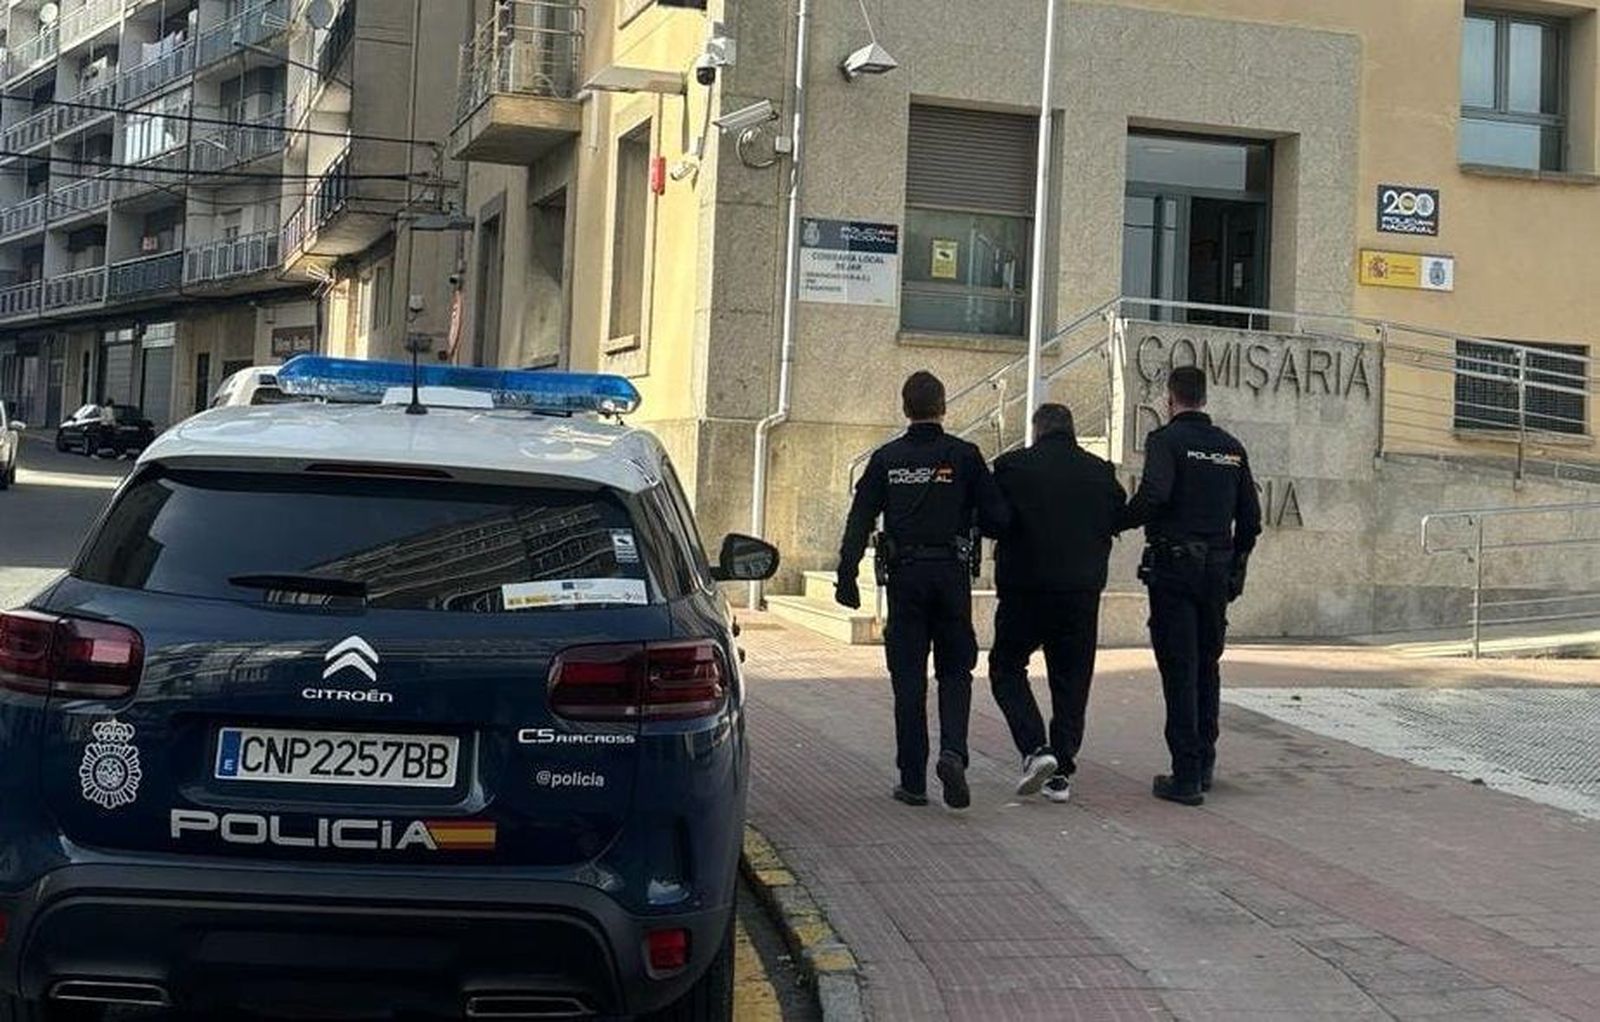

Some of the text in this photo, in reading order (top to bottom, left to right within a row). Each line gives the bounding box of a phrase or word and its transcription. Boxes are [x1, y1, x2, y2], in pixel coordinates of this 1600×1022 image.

[1383, 190, 1435, 217] 200
[858, 255, 884, 264] LOCAL
[1137, 336, 1371, 398] COMISARIA
[517, 727, 636, 745] C5 AIRCROSS
[223, 735, 449, 780] E CNP2257BB
[536, 769, 605, 789] @policia
